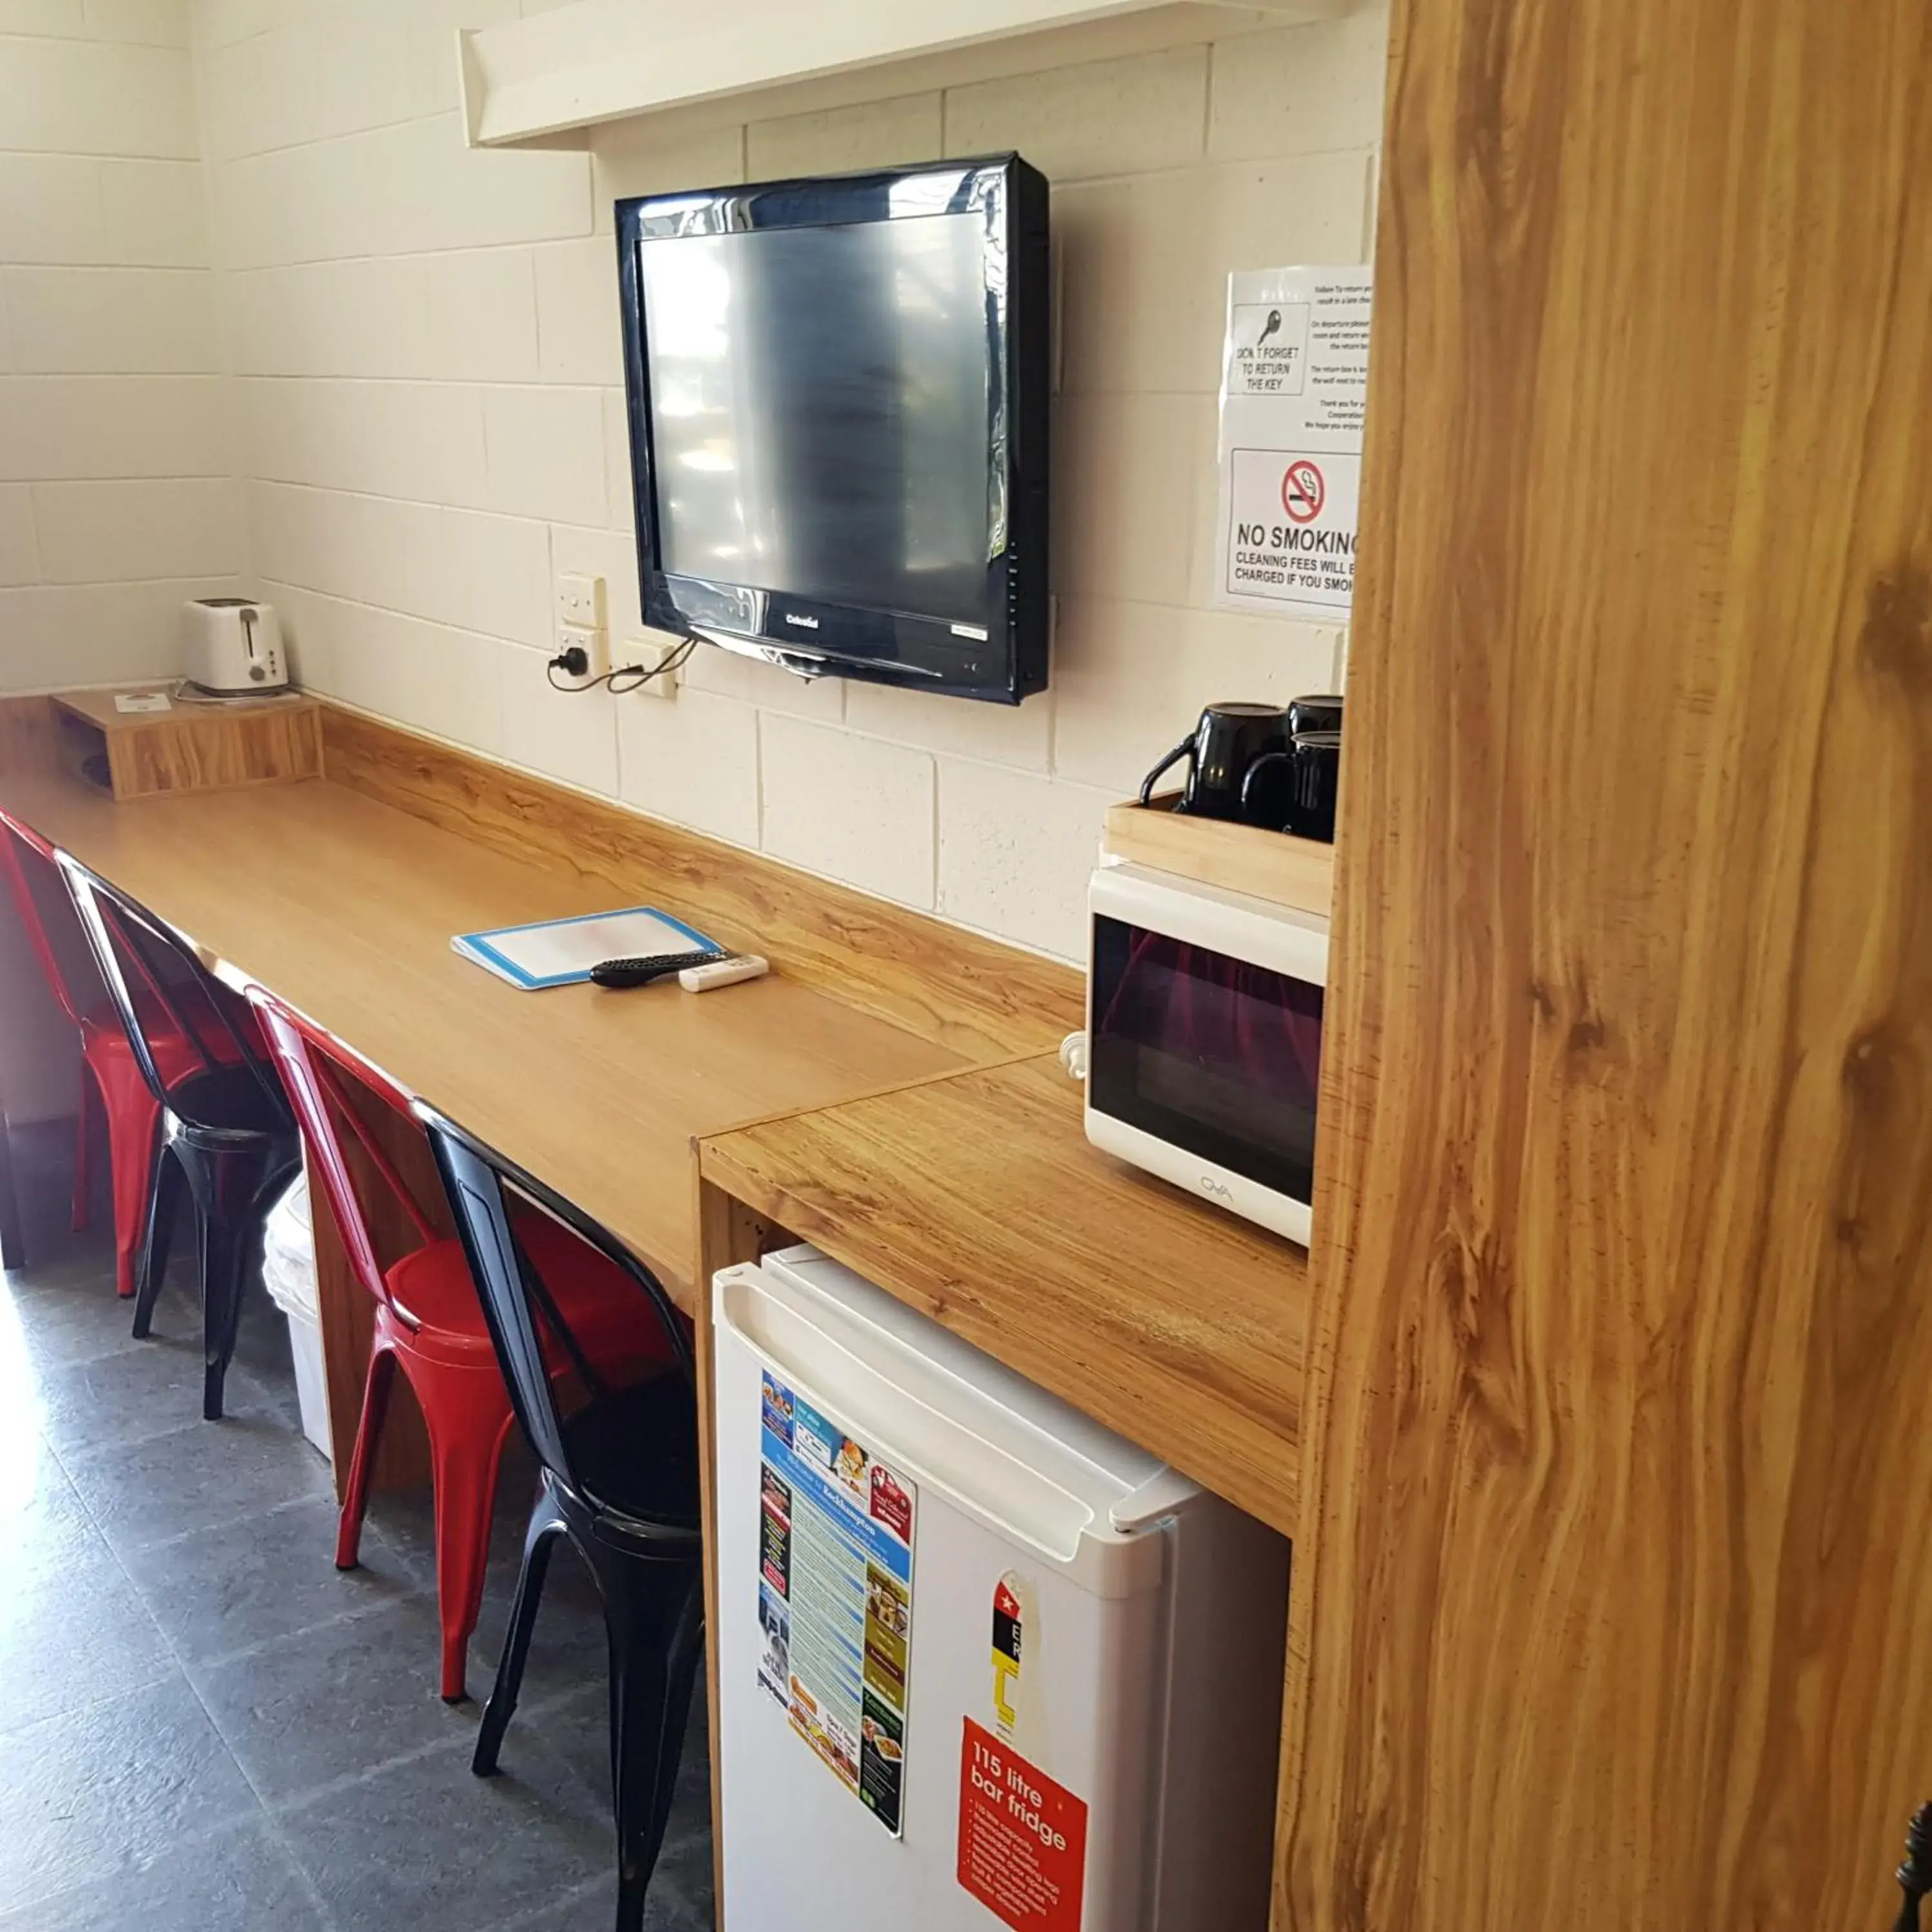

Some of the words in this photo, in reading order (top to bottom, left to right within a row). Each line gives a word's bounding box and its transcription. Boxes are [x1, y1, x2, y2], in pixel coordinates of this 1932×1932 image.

[1264, 347, 1299, 359] FORGET
[1242, 363, 1253, 375] TO
[1255, 363, 1290, 375] RETURN
[1247, 379, 1263, 390] THE
[1265, 379, 1283, 390] KEY
[1237, 523, 1265, 547] NO
[1236, 551, 1287, 567] CLEANING
[1290, 557, 1318, 571] FEES
[1320, 560, 1346, 574] WILL
[1349, 563, 1356, 575] B
[1235, 567, 1285, 584] CHARGED
[1287, 573, 1297, 585] IF
[1299, 575, 1322, 588] YOU
[1323, 577, 1352, 592] SMO
[974, 1741, 1001, 1777] 115
[1007, 1766, 1043, 1808] litre
[971, 1764, 1004, 1803] bar
[1008, 1794, 1066, 1852] fridge
